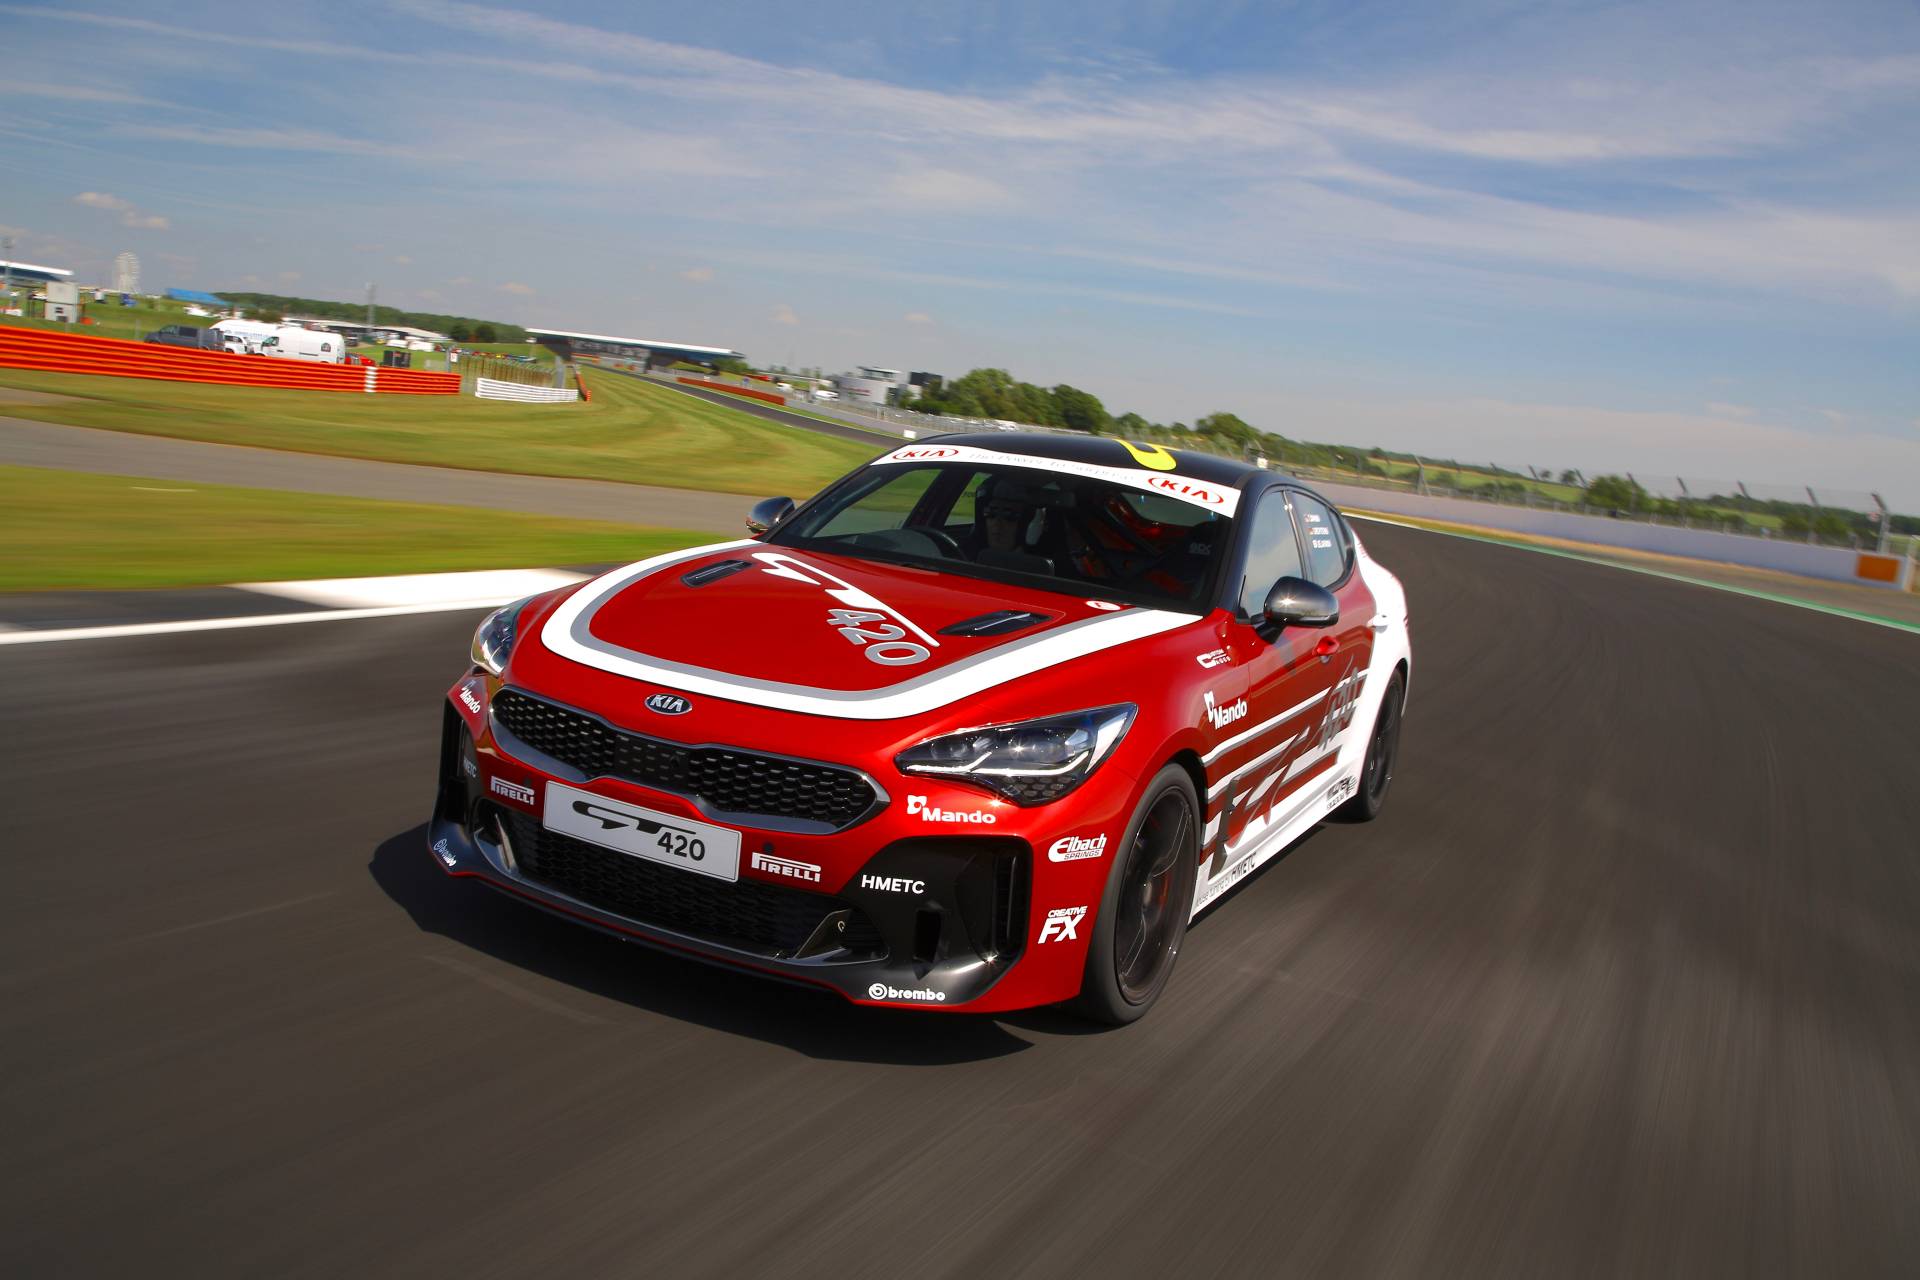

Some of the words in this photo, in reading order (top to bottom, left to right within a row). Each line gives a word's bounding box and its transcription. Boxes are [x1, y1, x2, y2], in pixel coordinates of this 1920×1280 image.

[1160, 479, 1209, 500] KIA
[826, 608, 931, 666] 420
[460, 686, 481, 714] Mando
[649, 694, 684, 712] KIA
[1213, 697, 1248, 729] Mando
[490, 776, 535, 805] PIRELLI
[922, 807, 996, 824] Mando
[657, 831, 706, 861] 420
[1048, 833, 1108, 862] Eibach
[1064, 848, 1101, 860] SPRINGS
[751, 852, 821, 882] PIRELLI
[861, 874, 925, 895] HMETC
[1048, 905, 1088, 918] CREATIVE
[1037, 913, 1086, 944] FX
[888, 985, 946, 1002] brembo
